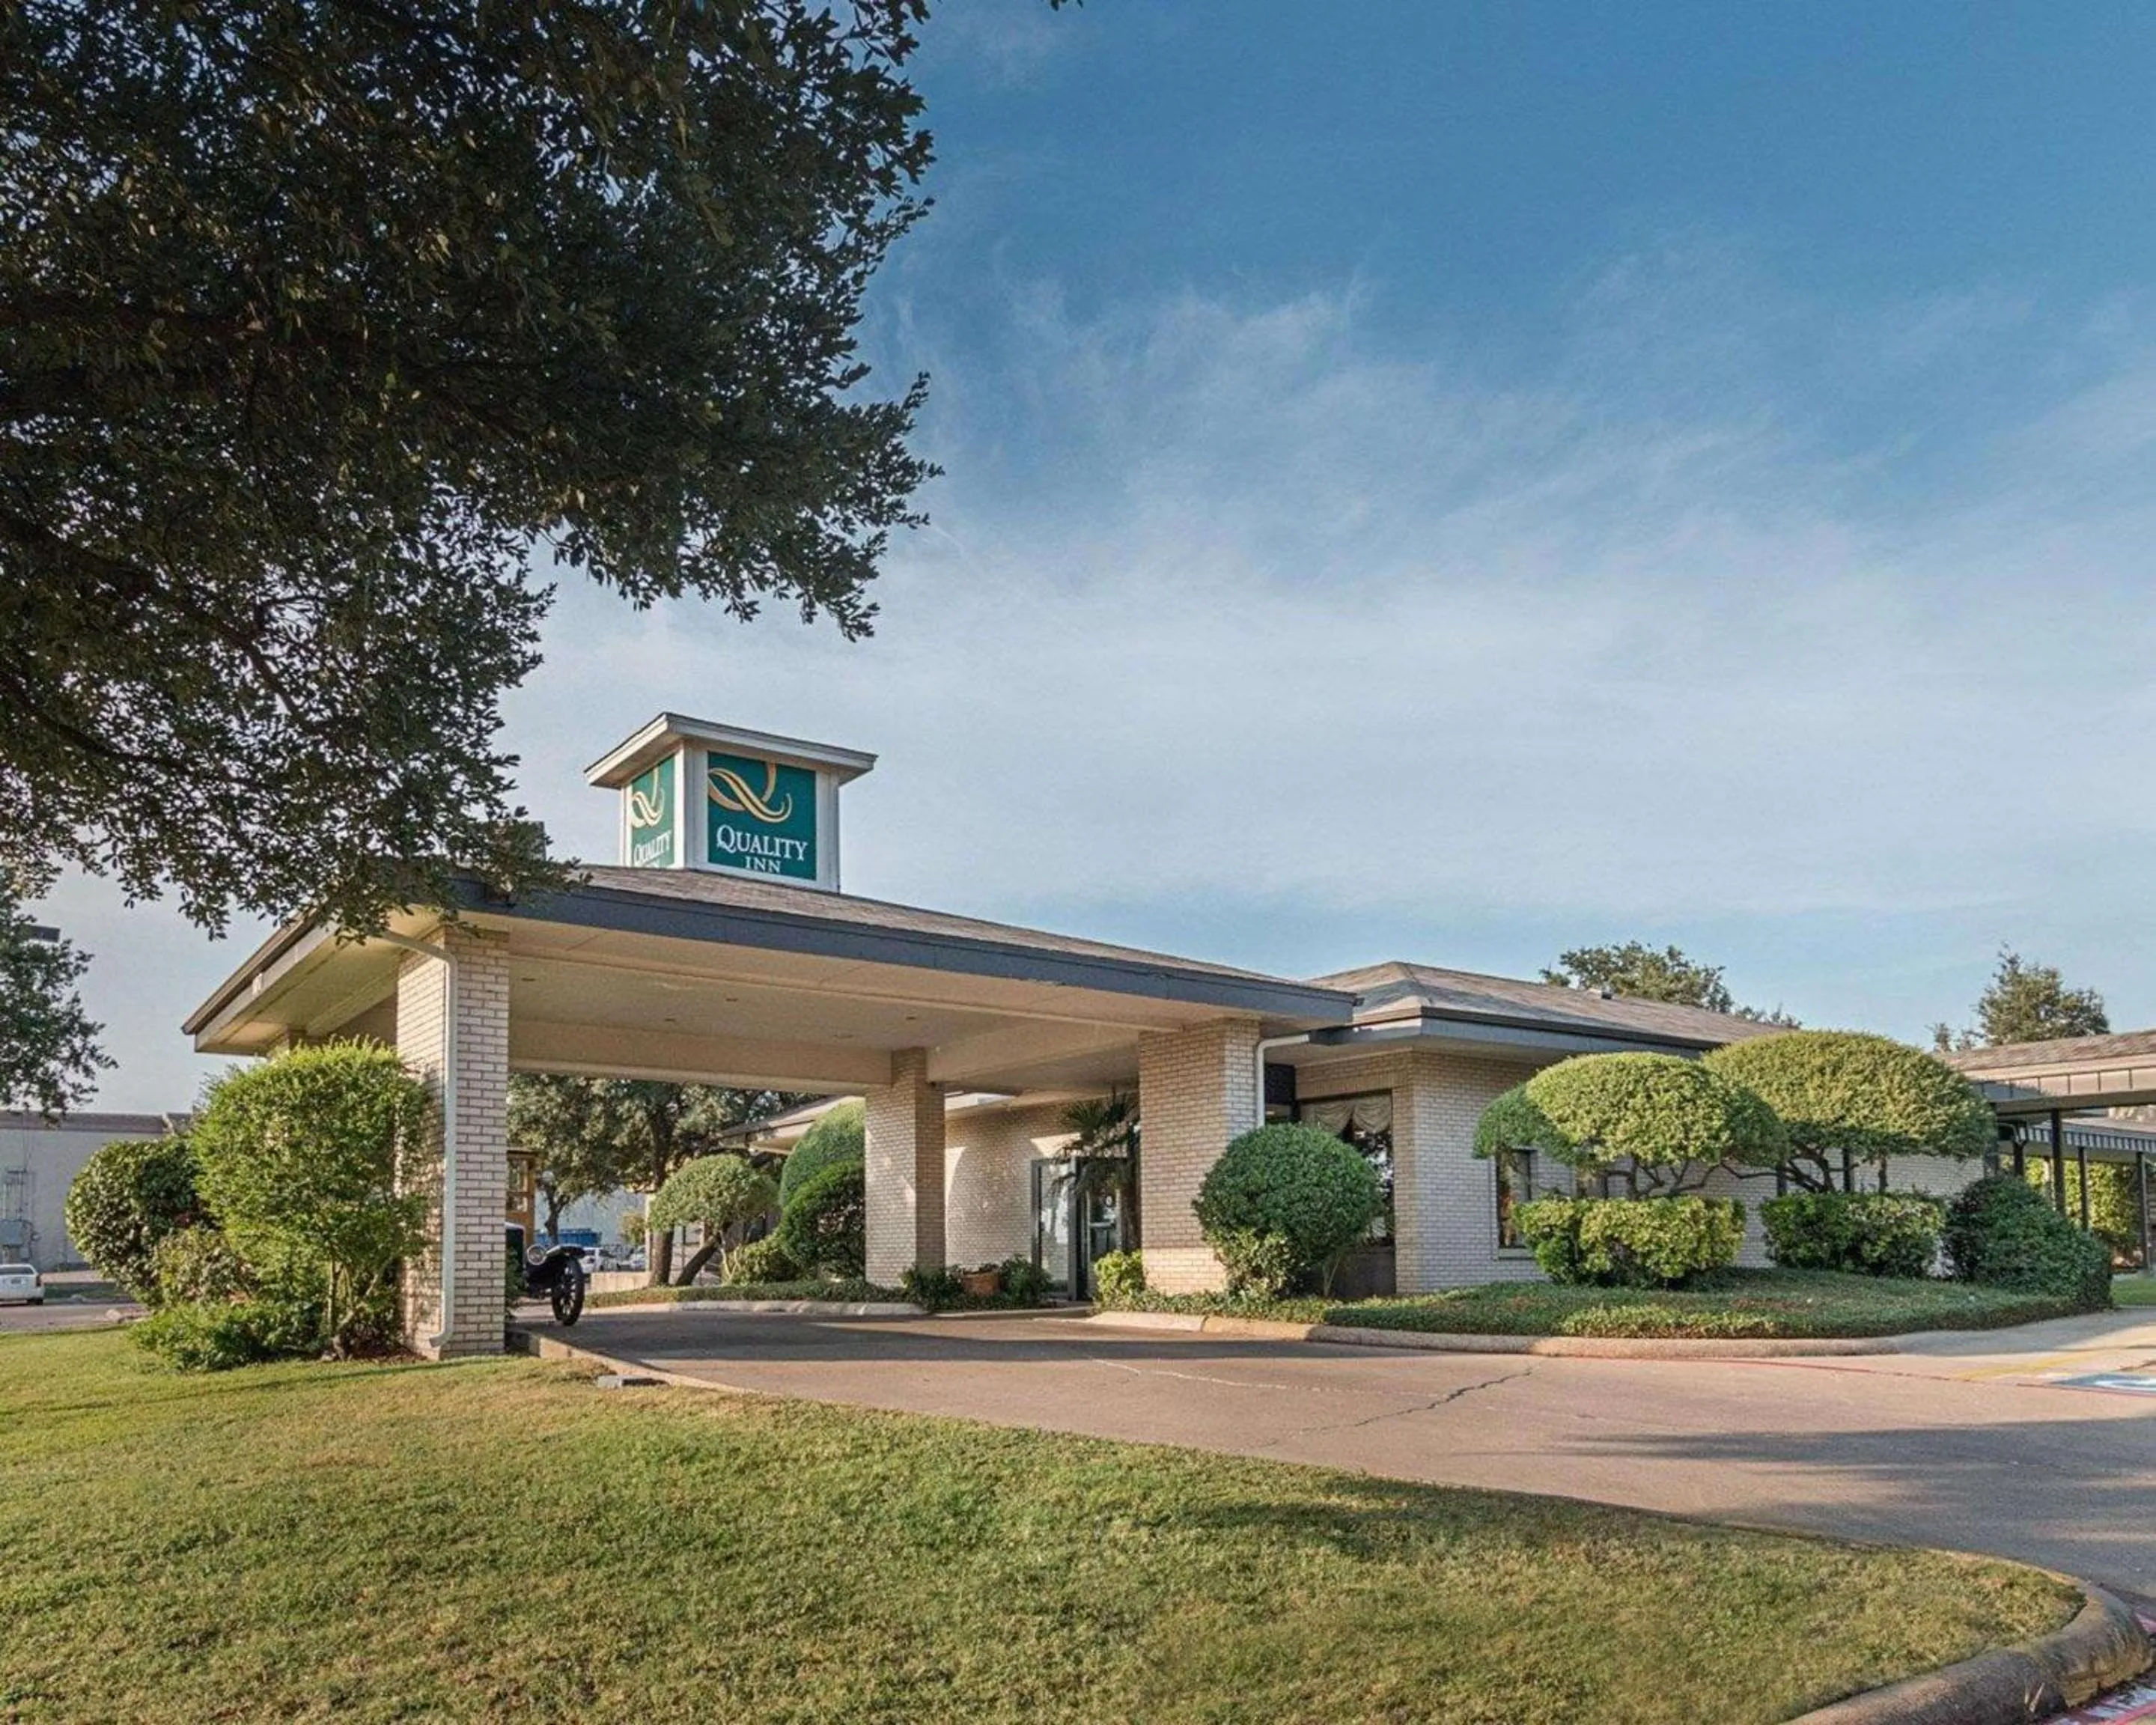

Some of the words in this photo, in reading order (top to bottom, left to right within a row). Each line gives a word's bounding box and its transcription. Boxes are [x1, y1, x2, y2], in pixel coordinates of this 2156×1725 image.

[633, 830, 672, 865] QUALITY
[716, 824, 808, 861] QUALITY
[745, 856, 782, 873] INN
